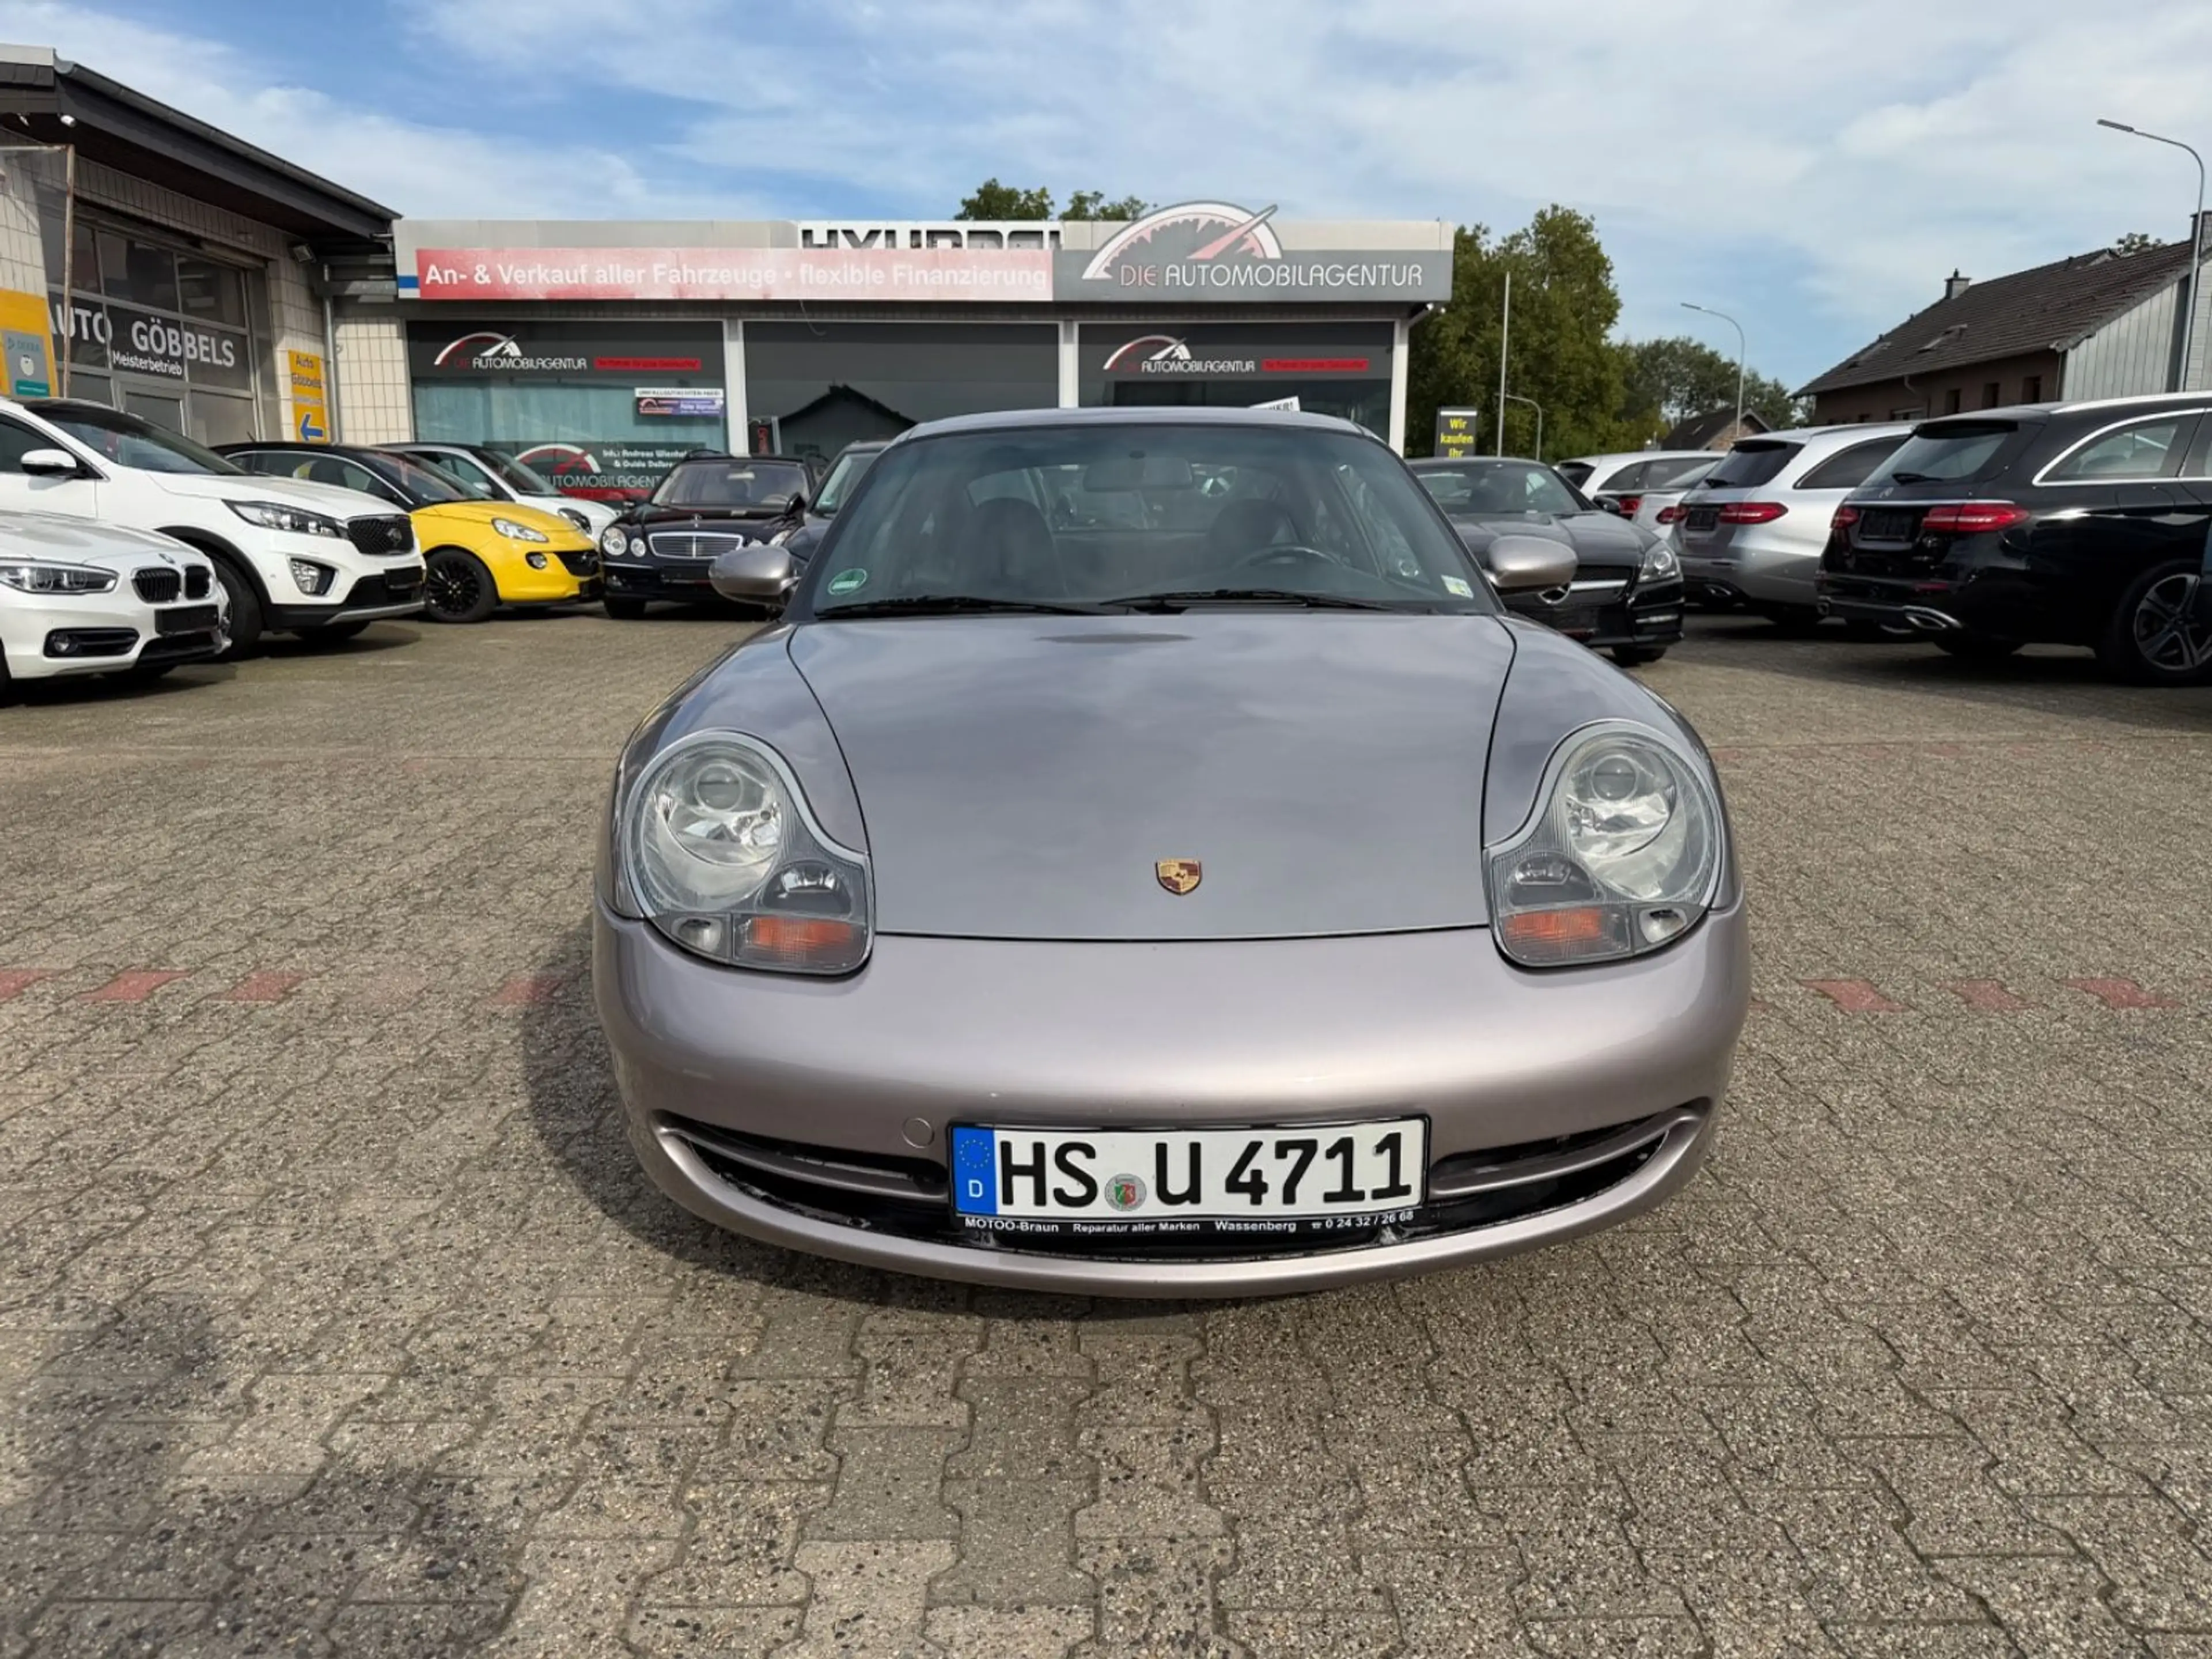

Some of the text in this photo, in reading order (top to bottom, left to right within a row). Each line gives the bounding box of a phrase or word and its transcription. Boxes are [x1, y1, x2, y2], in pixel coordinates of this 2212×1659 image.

[426, 263, 1047, 288] An- & Verkauf aller Fahrzeuge flexible Finanzierung
[1121, 264, 1422, 286] DIE AUTOMOBILAGENTUR
[131, 317, 234, 368] GÖBBELS
[112, 350, 182, 376] Meisterbetrieb
[472, 357, 587, 369] AUTOMOBILAGENTUR
[1141, 360, 1255, 373] AUTOMOBILAGENTUR
[1449, 418, 1467, 430] Wir
[1441, 433, 1474, 444] kaufen
[968, 1132, 1412, 1208] D HS U 4711
[965, 1217, 1059, 1233] MOTOO-Braun
[1073, 1223, 1128, 1234] Reparatur
[1132, 1223, 1156, 1233] aller
[1158, 1221, 1199, 1232] Marken
[1215, 1220, 1296, 1233] Wassenberg
[1325, 1218, 1334, 1229] 0
[1336, 1217, 1352, 1228] 24
[1355, 1215, 1371, 1228] 32
